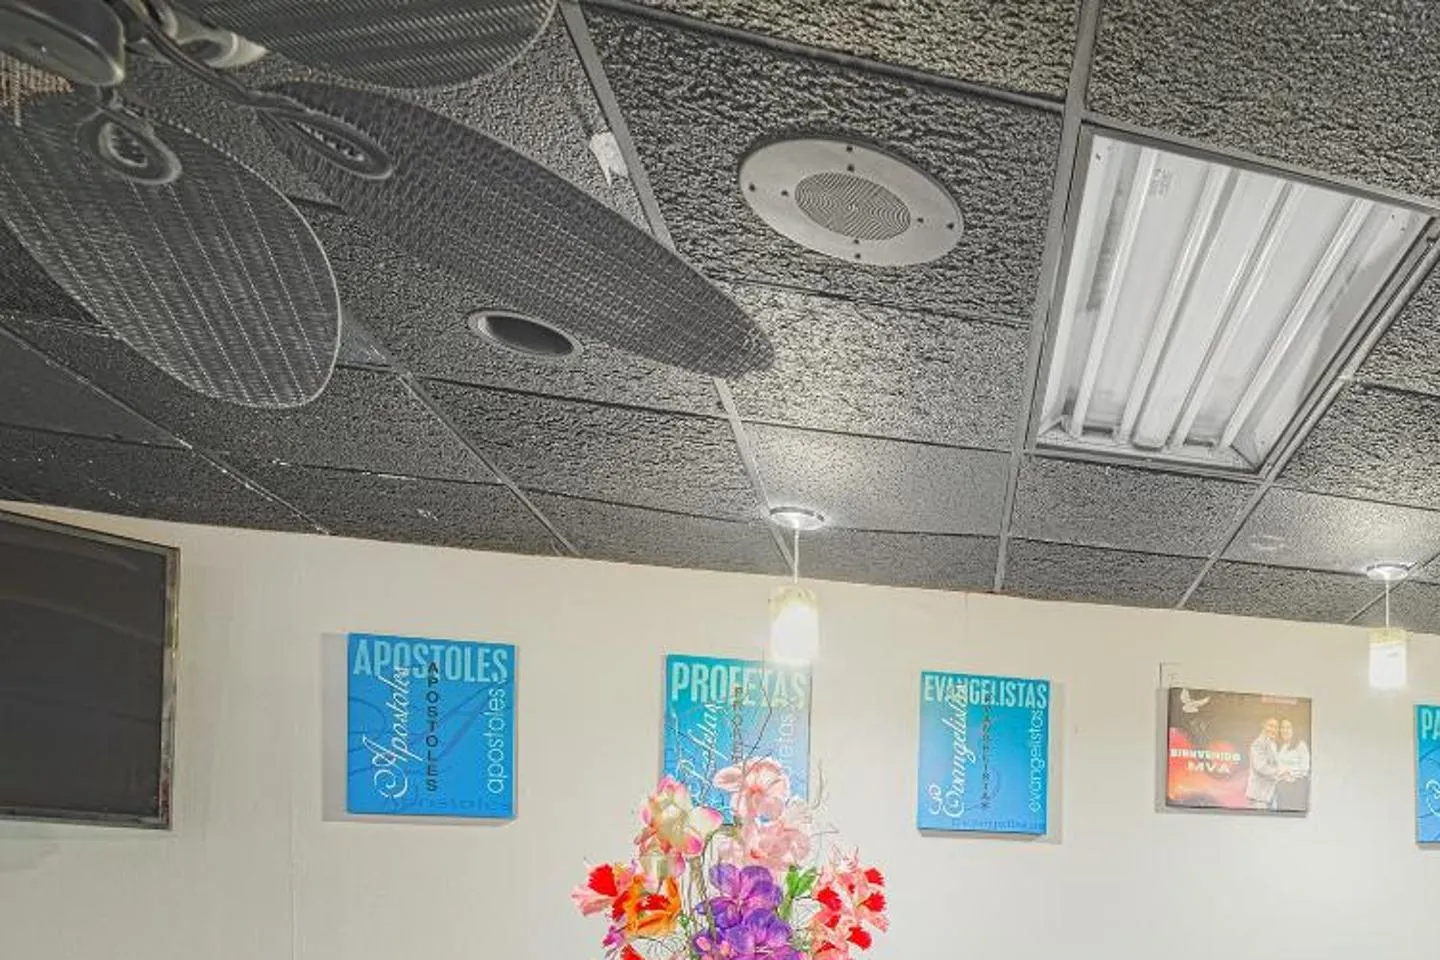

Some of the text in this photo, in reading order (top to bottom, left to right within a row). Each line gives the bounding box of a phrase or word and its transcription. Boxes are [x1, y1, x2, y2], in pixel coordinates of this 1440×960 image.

[352, 638, 509, 683] APOSTOLES
[671, 662, 808, 710] PROFETAS
[923, 674, 1048, 710] EVANGELISTAS
[425, 662, 439, 792] APOSTOLES
[483, 687, 508, 794] apostoles
